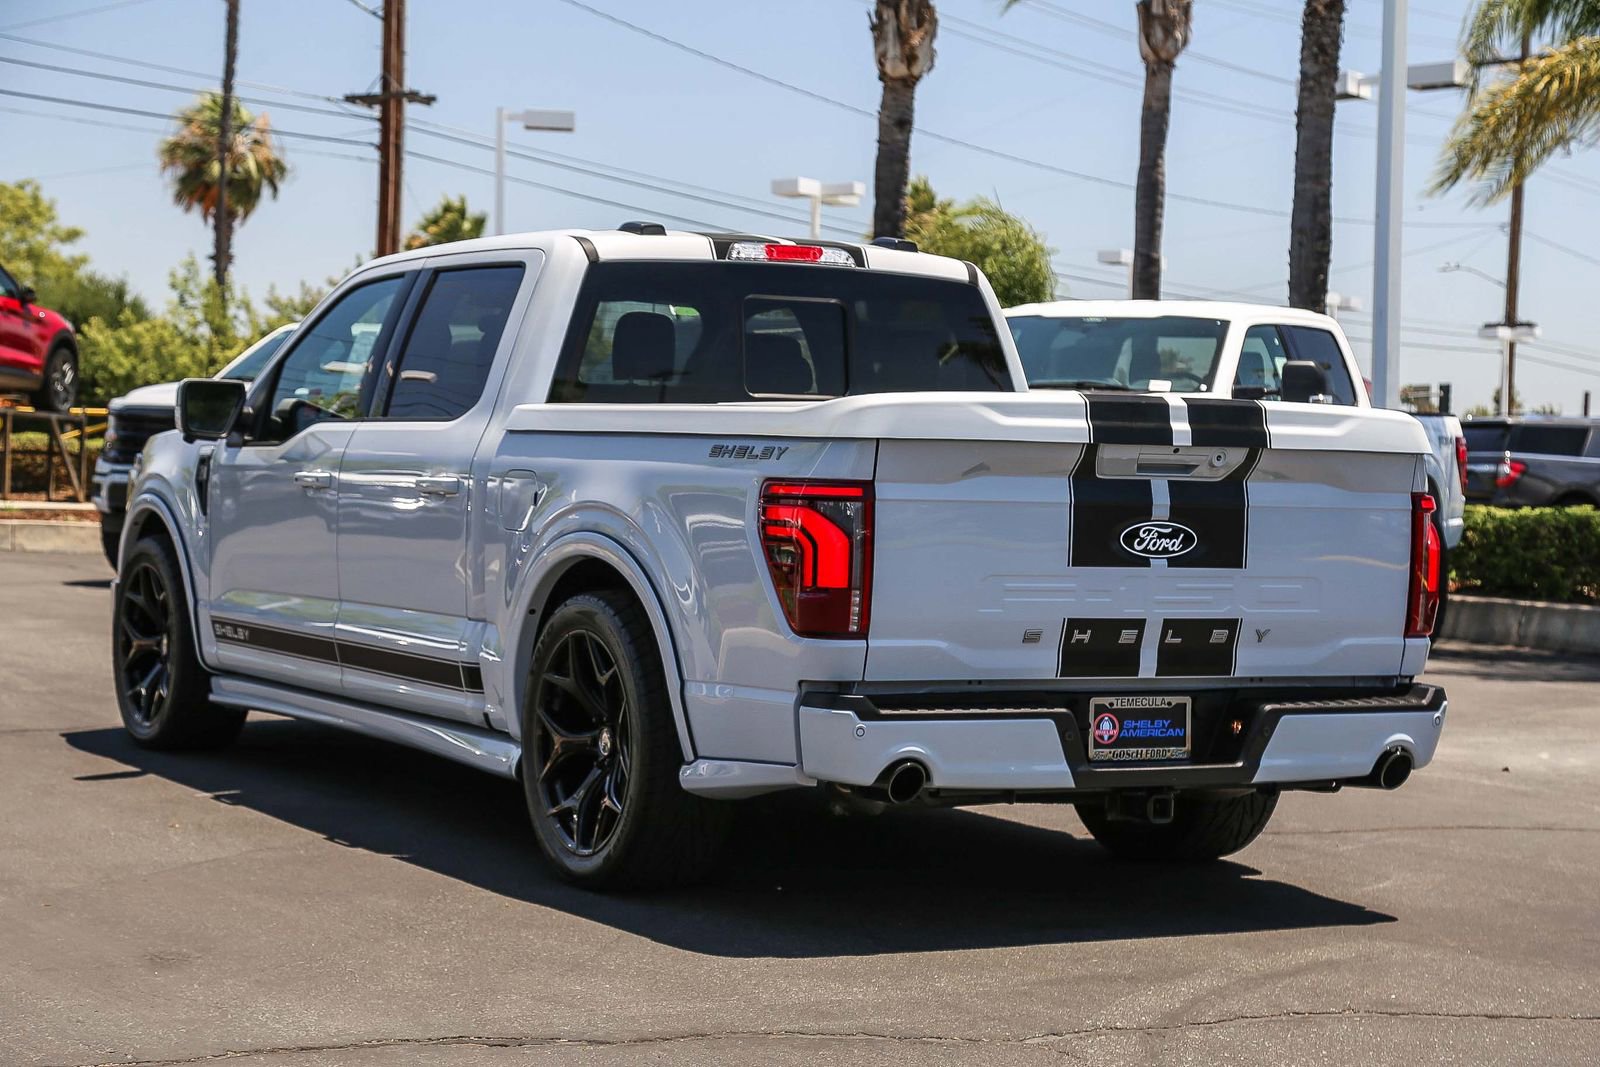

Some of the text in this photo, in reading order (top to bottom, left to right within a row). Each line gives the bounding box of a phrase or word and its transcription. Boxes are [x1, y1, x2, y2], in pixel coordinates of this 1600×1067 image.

[708, 444, 790, 461] SHELBY
[1133, 526, 1184, 551] Ford
[214, 623, 249, 640] SHELBY
[1022, 629, 1271, 644] SHELBY
[1115, 698, 1167, 707] TEMECULA
[1123, 720, 1172, 729] SHELBY
[1120, 728, 1185, 737] AMERICAN
[1145, 749, 1167, 759] FORD
